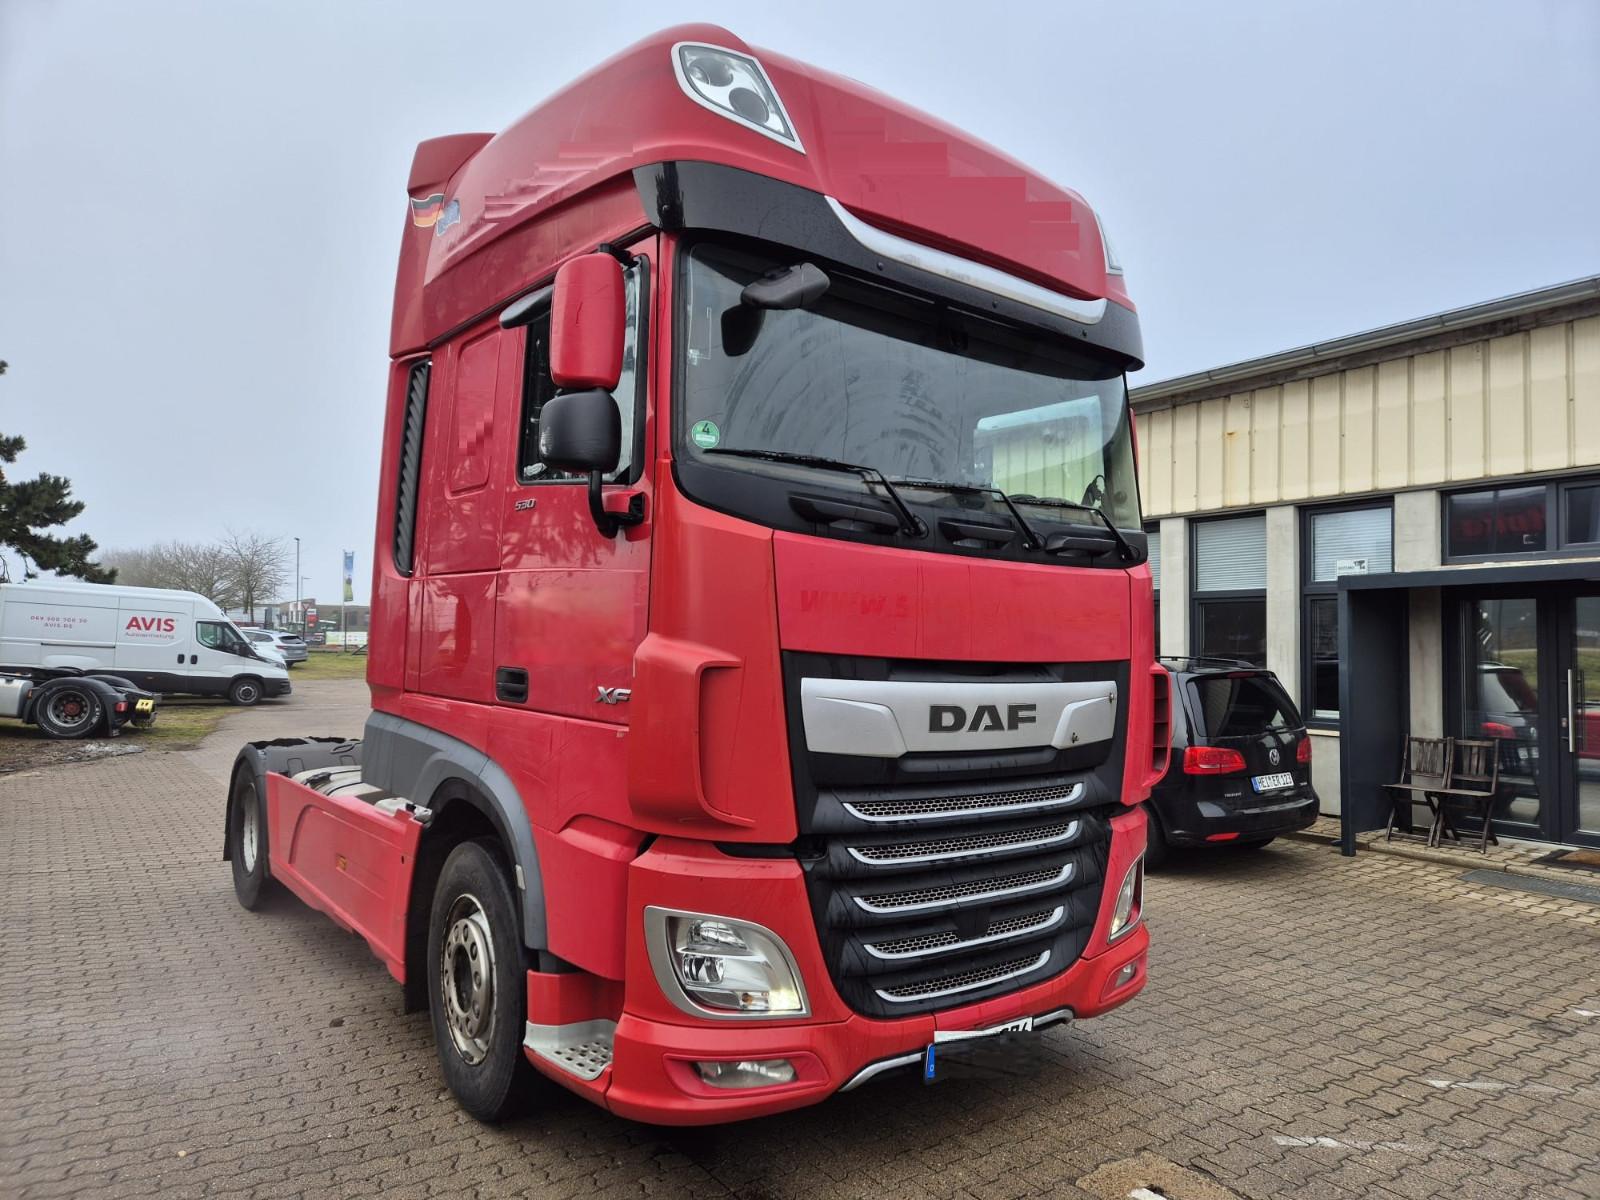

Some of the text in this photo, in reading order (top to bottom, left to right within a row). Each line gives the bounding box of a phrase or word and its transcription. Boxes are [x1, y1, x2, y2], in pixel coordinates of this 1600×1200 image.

[701, 423, 710, 434] 4
[126, 616, 175, 632] AVIS
[596, 686, 632, 704] XF
[928, 703, 1037, 733] DAF
